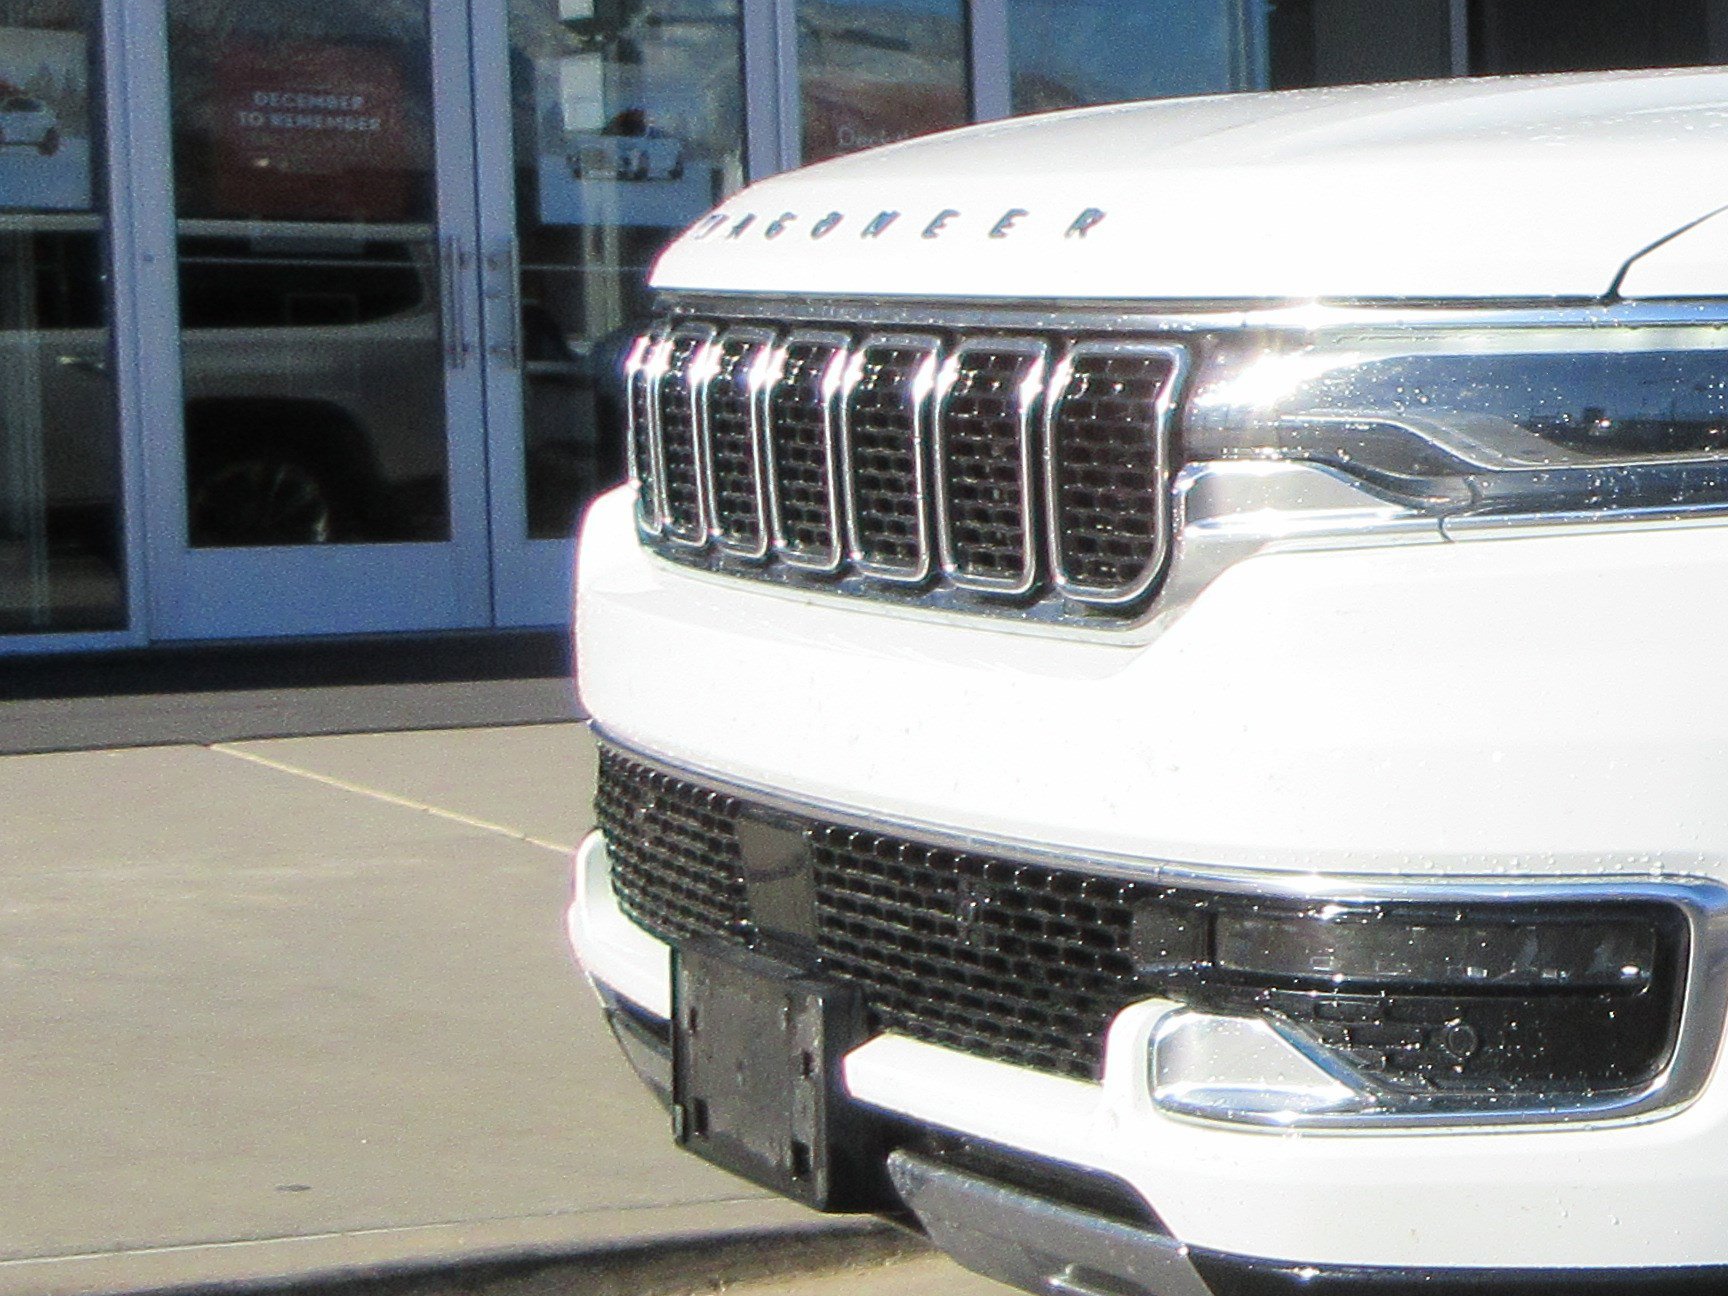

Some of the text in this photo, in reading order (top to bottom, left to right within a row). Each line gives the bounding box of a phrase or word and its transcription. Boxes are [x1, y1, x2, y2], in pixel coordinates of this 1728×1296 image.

[252, 91, 365, 110] DECEMBER
[237, 111, 382, 131] TO REMEMBER
